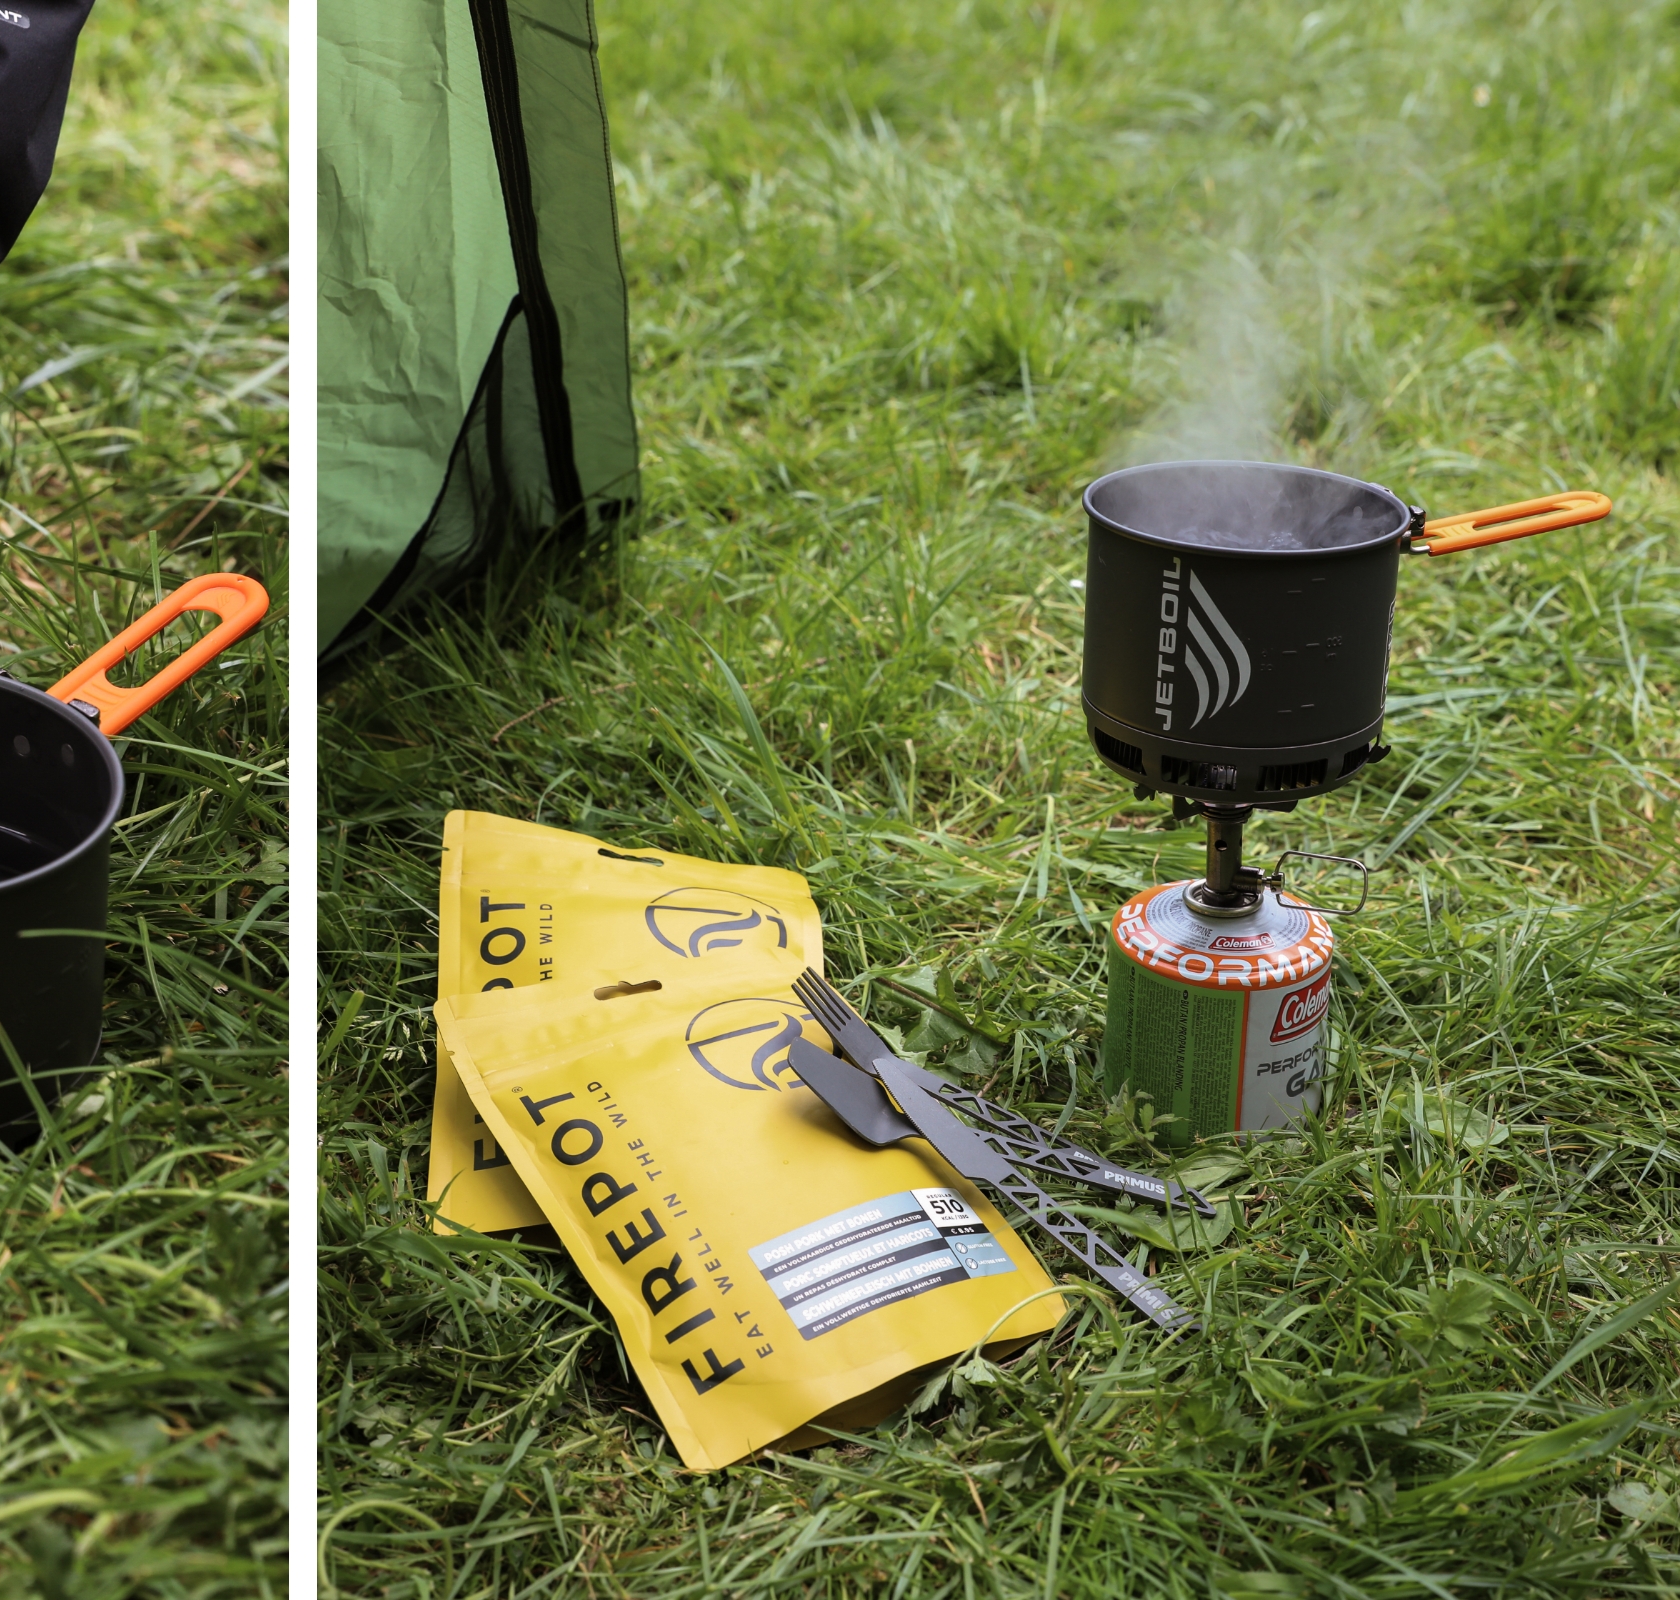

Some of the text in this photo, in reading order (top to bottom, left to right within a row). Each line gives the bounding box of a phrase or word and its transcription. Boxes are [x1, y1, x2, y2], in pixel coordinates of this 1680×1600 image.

[1155, 556, 1181, 731] JETBOIL
[539, 903, 553, 945] WILD
[1215, 937, 1262, 948] Coleman
[1285, 1058, 1321, 1098] GA
[929, 1199, 965, 1215] 510
[1104, 1170, 1166, 1195] PRIMUS
[519, 1091, 746, 1396] FIREPOT
[586, 1081, 774, 1359] EAT WELL IN THE WILD
[763, 1208, 883, 1263] POSH PORK MET BONEN
[773, 1263, 788, 1273] EEN
[782, 1227, 934, 1291] PORC SOMPTUEUX ET HARICOTS
[793, 1293, 804, 1302] UN
[804, 1283, 826, 1297] REPAS
[867, 1256, 897, 1271] COMPLET
[802, 1256, 954, 1321] SCHWEINEFLEISCH MIT BOHNEN
[812, 1322, 824, 1332] EIN
[824, 1302, 871, 1327] VOLLWERTIGE
[912, 1276, 943, 1291] MAHLZEIT
[1118, 1271, 1175, 1321] PRIMUS
